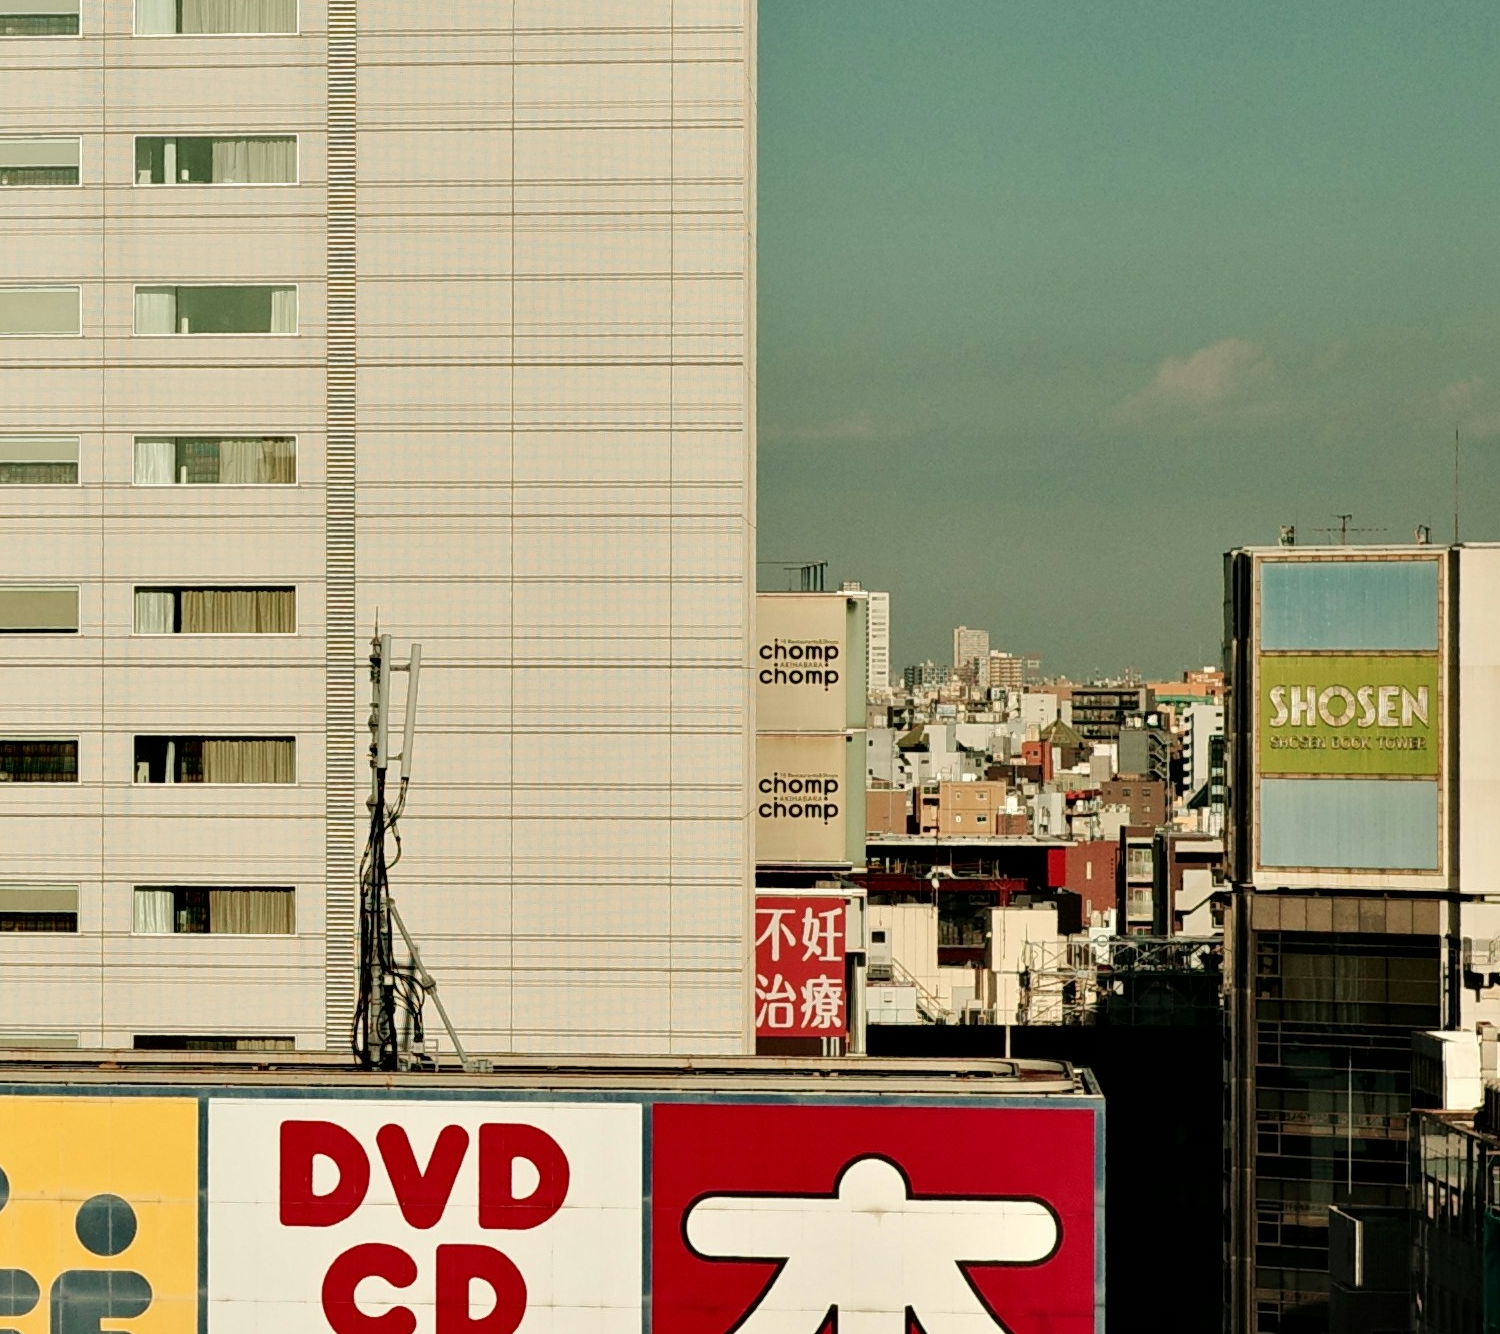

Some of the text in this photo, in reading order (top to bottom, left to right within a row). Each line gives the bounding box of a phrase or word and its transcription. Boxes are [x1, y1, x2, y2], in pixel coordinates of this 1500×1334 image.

[759, 640, 839, 664] chomp
[759, 668, 839, 689] chomp
[1269, 685, 1429, 729] SHOSEN
[1270, 735, 1427, 750] SHOSEN BOOK TOWER
[759, 774, 839, 798] chomp
[759, 802, 839, 823] chomp
[756, 907, 843, 963] 不妊
[756, 973, 843, 1028] 治療
[279, 1119, 570, 1231] DVD
